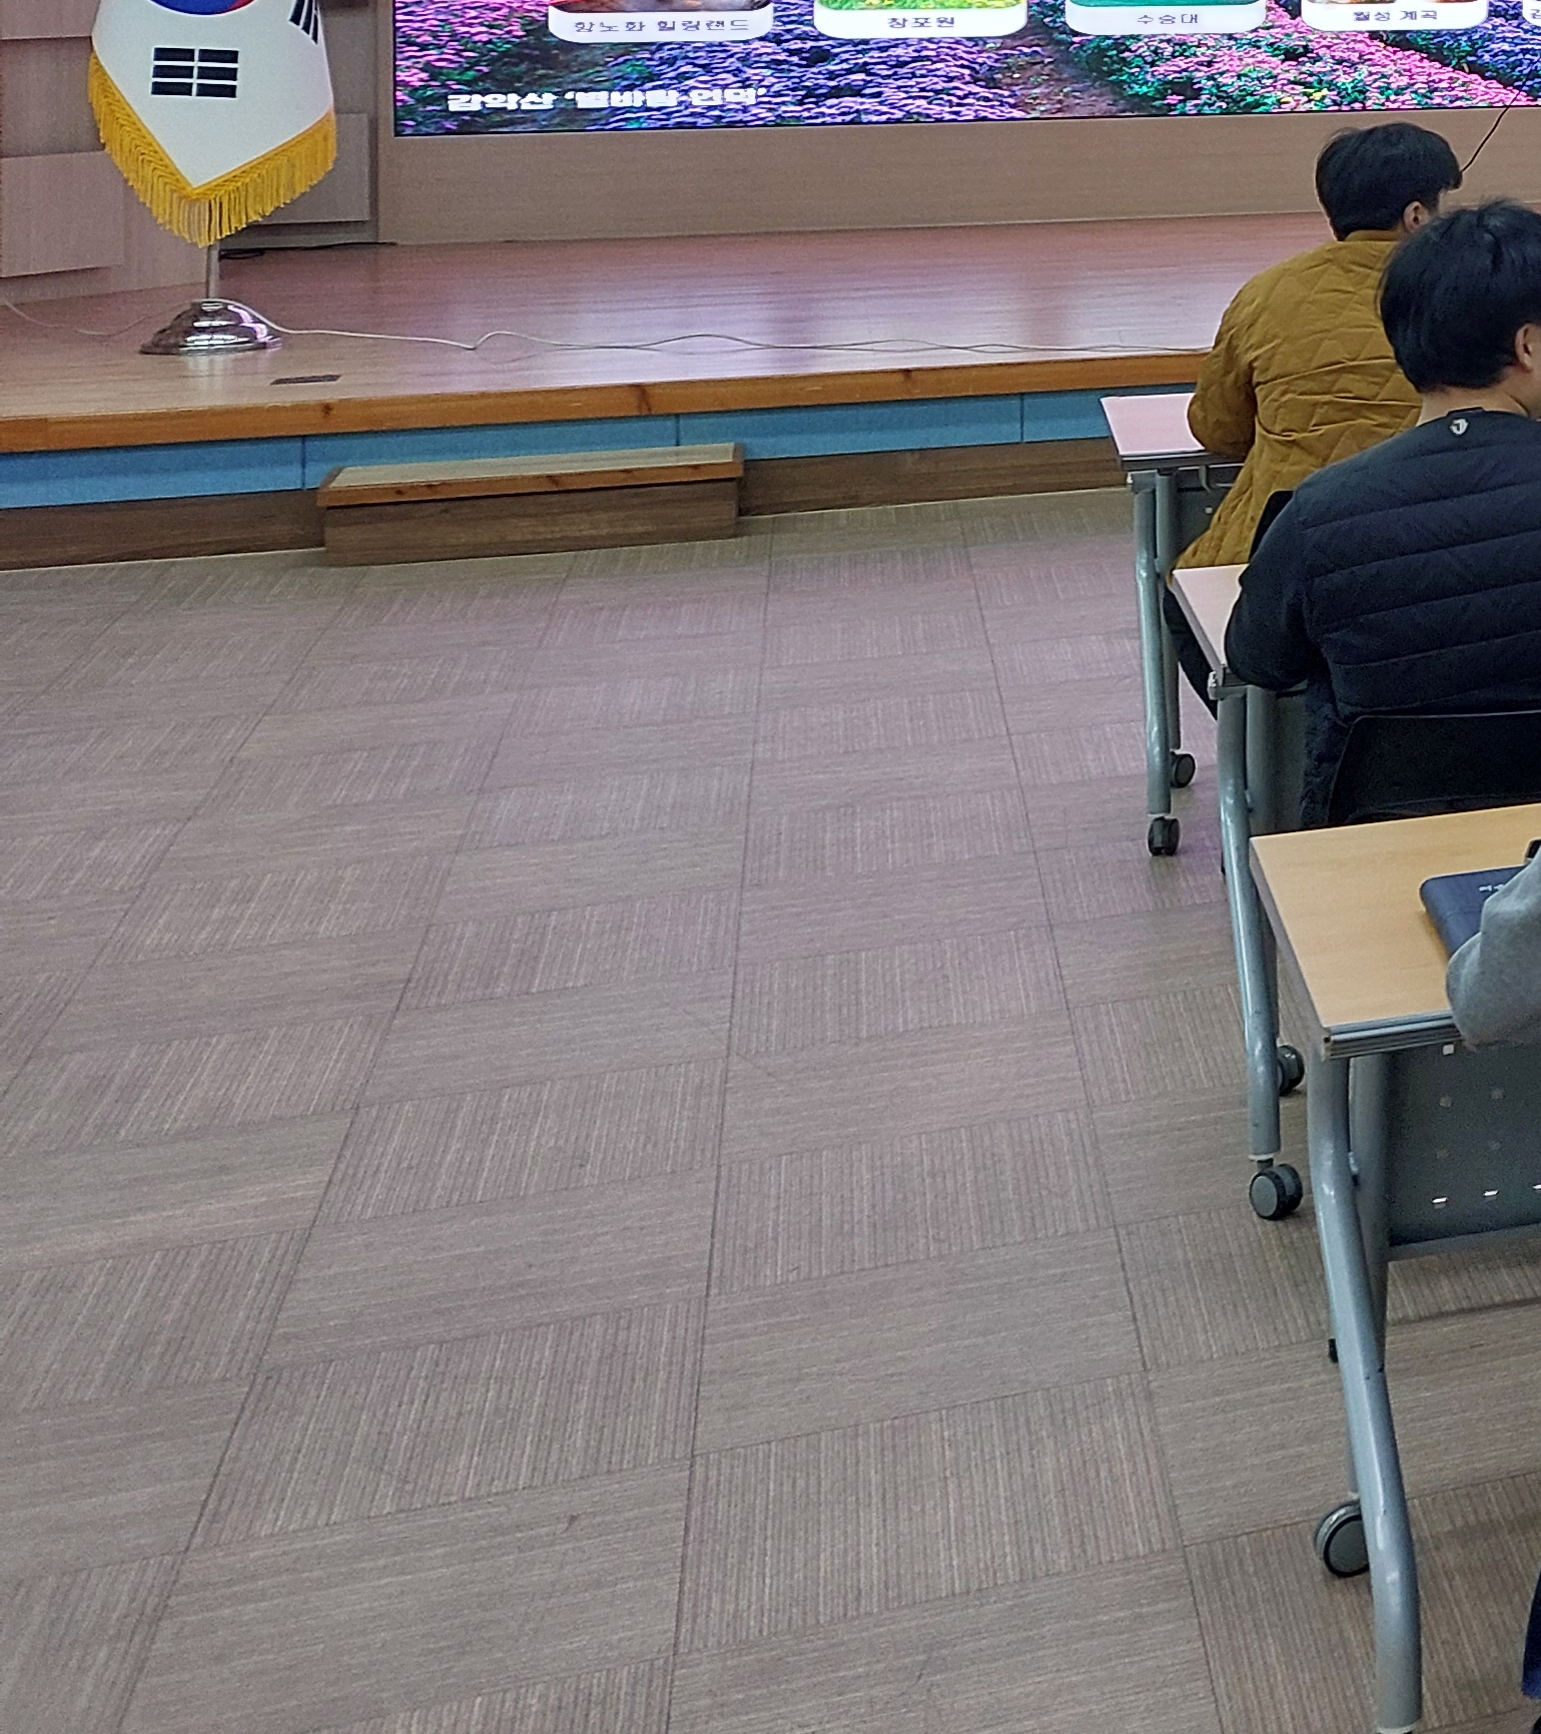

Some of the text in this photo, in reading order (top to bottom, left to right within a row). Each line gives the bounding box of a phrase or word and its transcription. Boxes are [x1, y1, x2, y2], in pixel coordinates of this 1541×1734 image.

[1136, 12, 1200, 26] 수승대
[1398, 9, 1439, 21] 계곡
[446, 92, 559, 113] 감악산
